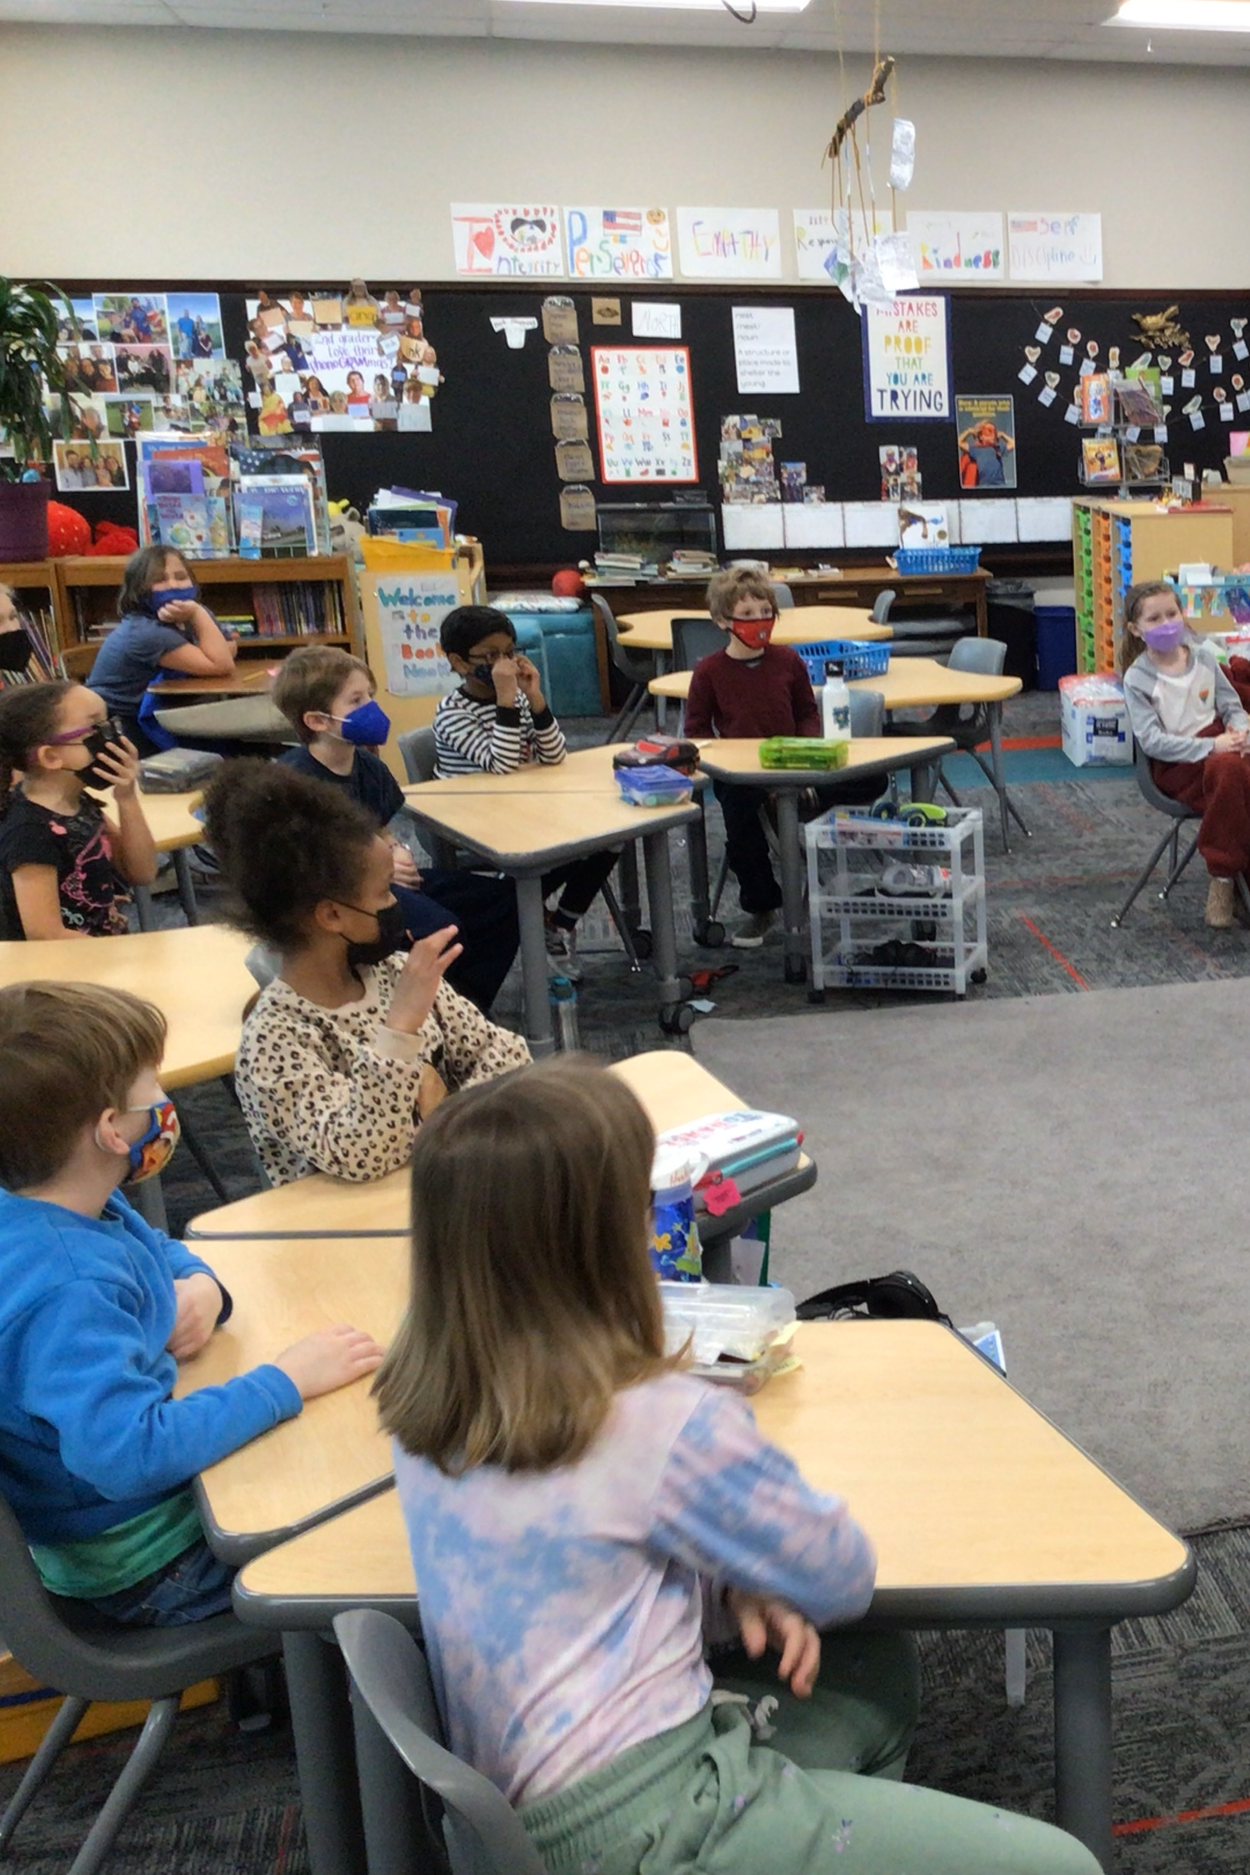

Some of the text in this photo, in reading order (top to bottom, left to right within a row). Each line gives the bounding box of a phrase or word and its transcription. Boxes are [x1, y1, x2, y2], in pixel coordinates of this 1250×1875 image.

[897, 319, 918, 333] ARE
[884, 334, 932, 356] PROOF
[895, 356, 924, 371] THAT
[886, 372, 934, 386] YOU ARE
[876, 388, 944, 413] TRYING
[378, 586, 456, 608] Welcome
[406, 608, 431, 624] to
[403, 623, 438, 641] the
